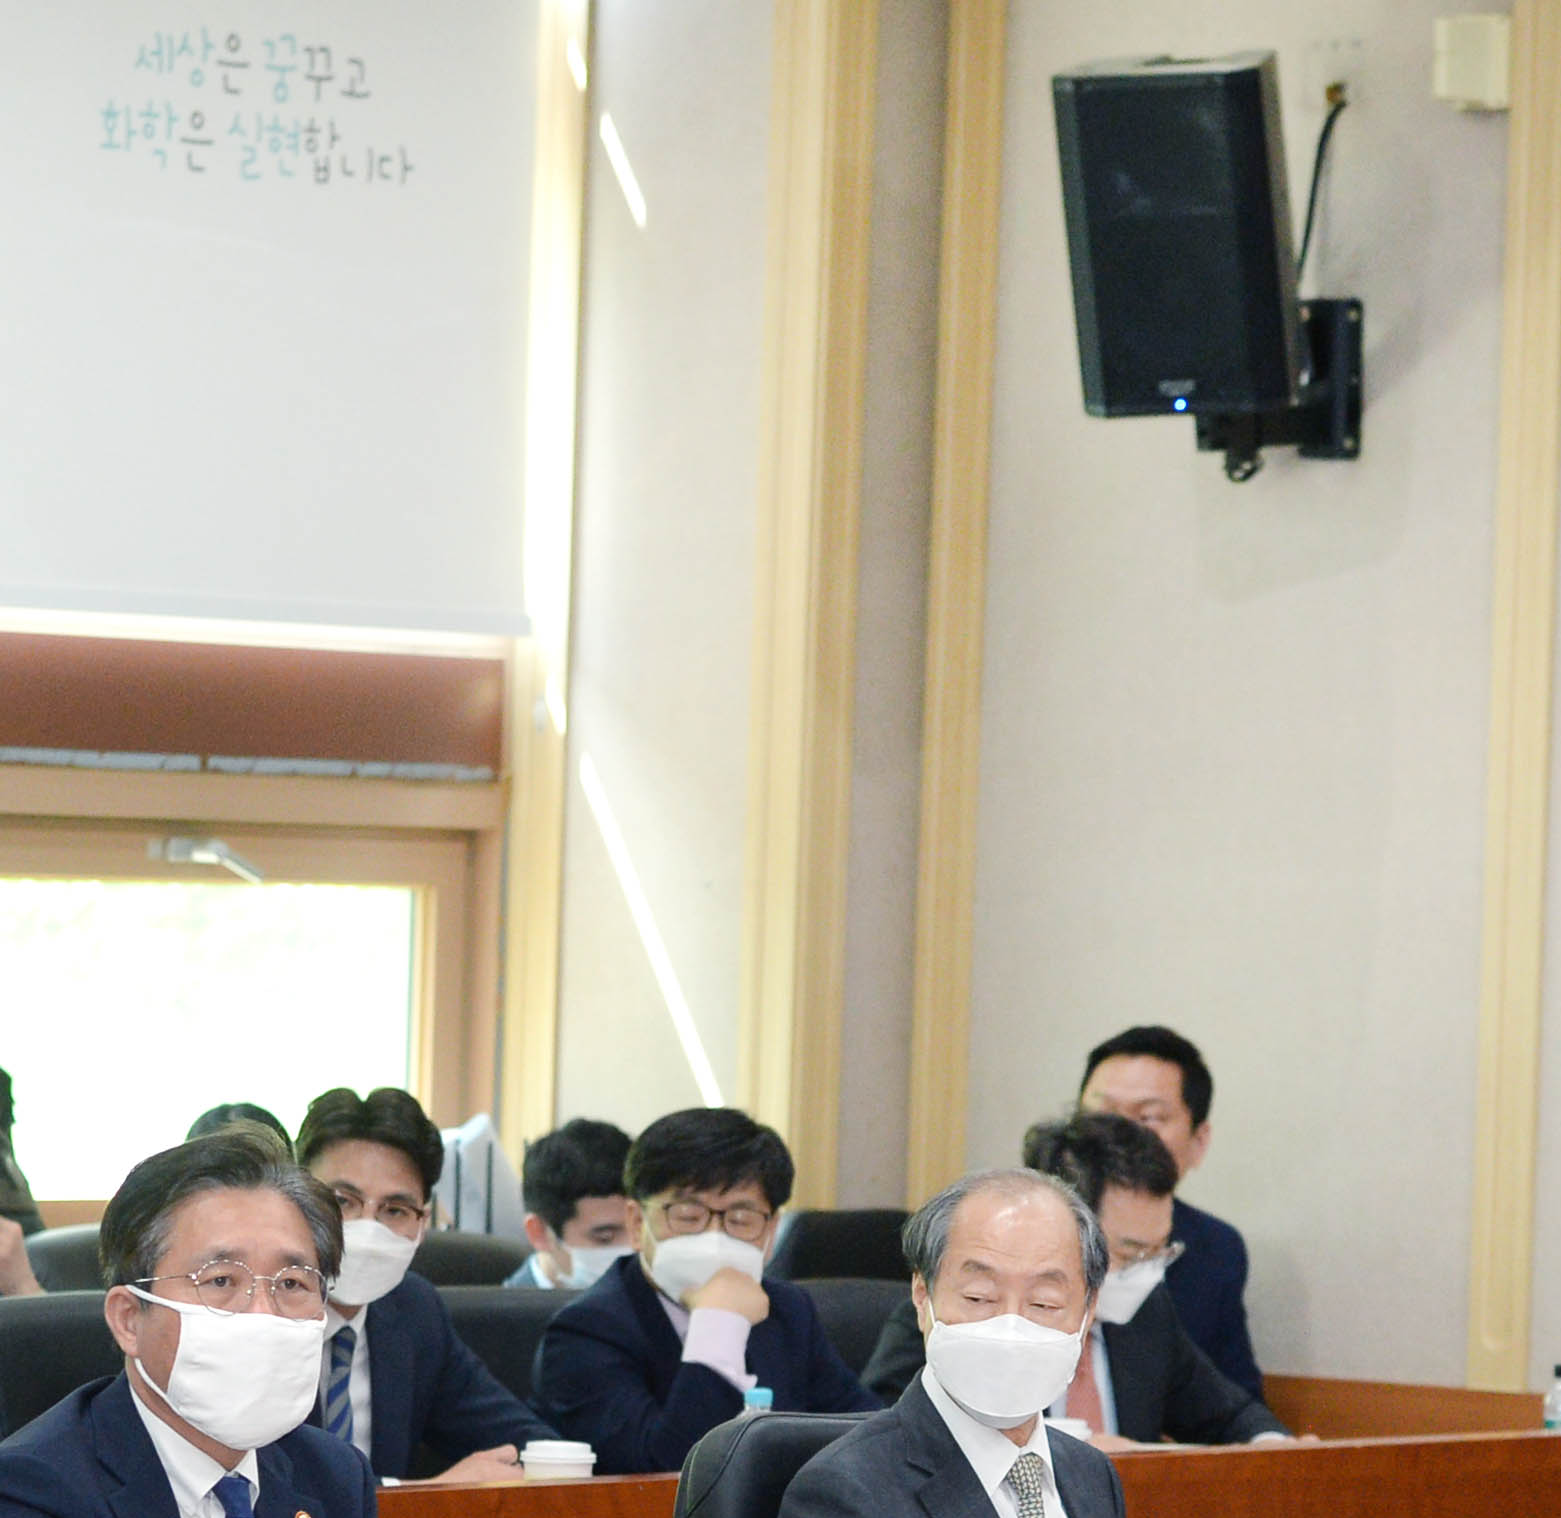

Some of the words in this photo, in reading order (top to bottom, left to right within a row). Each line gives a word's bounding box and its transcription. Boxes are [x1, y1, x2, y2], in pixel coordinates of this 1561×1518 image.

[133, 26, 252, 95] 세상은
[99, 99, 215, 174] 화학은
[228, 111, 416, 185] 실현합니다
